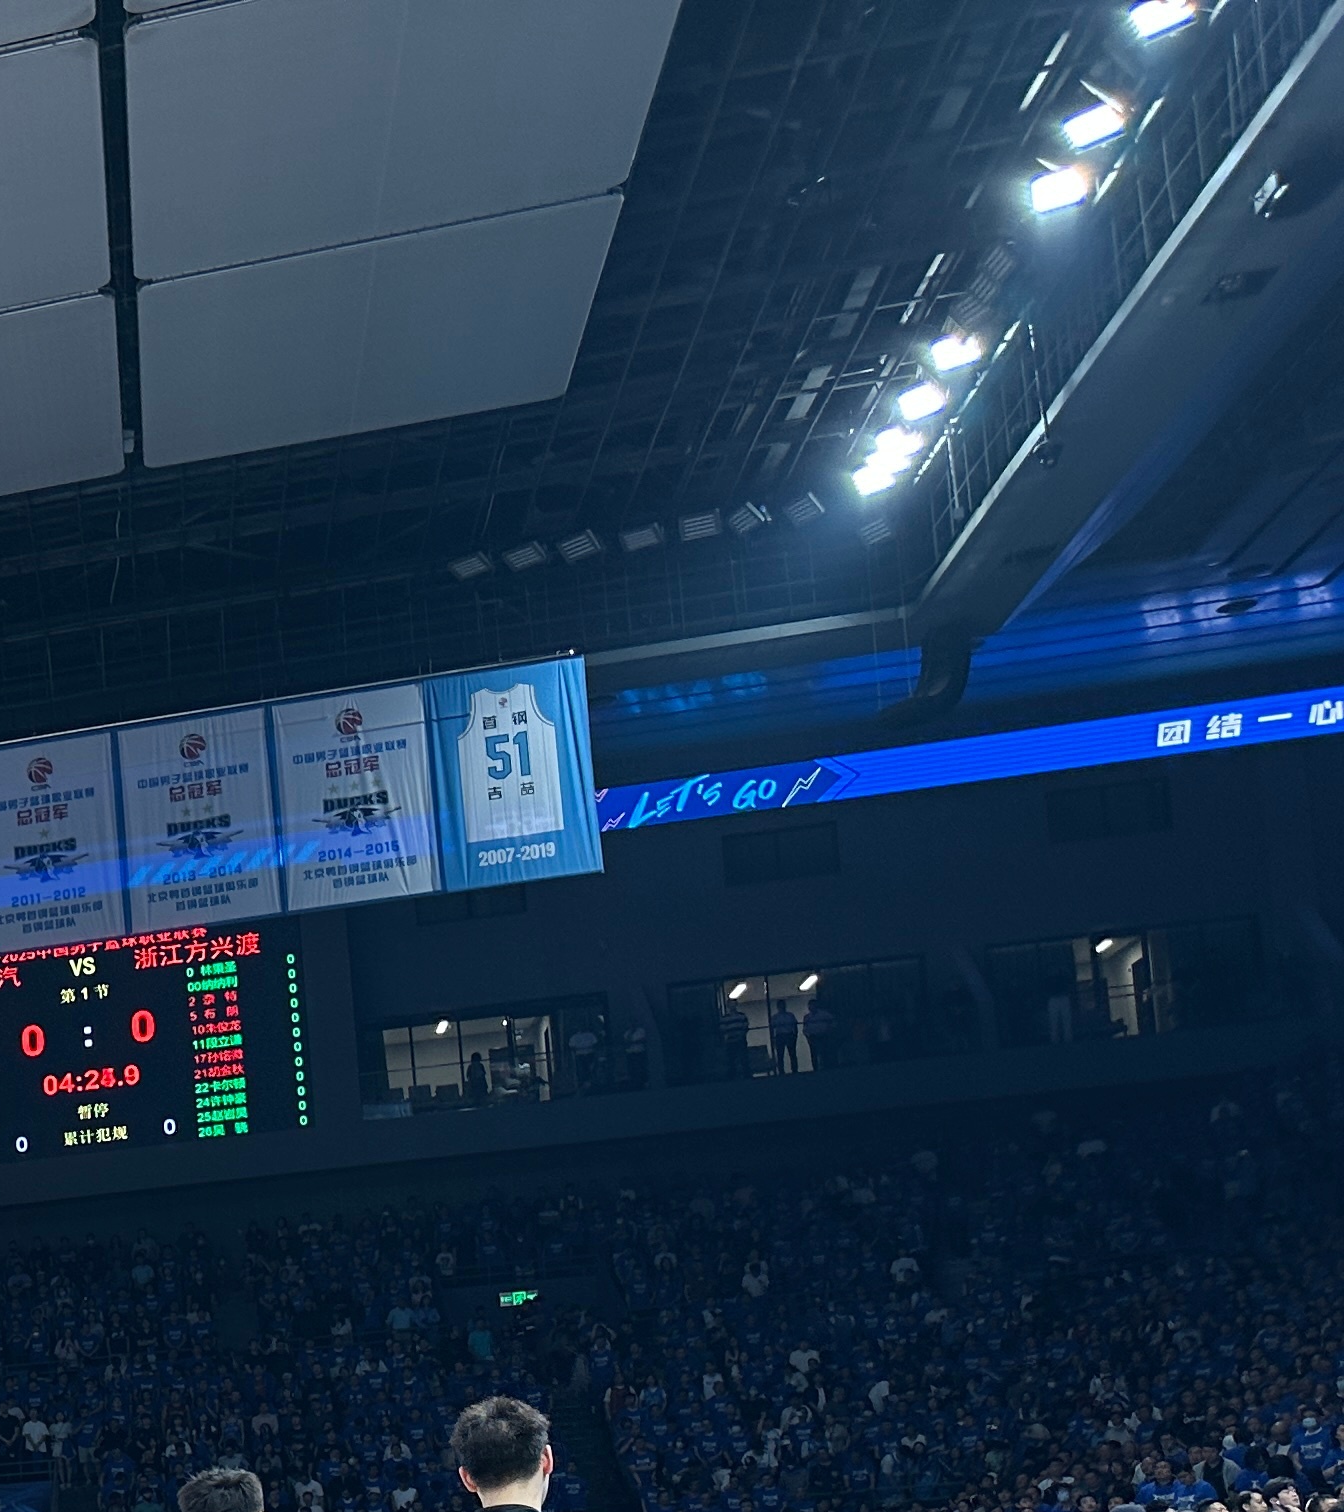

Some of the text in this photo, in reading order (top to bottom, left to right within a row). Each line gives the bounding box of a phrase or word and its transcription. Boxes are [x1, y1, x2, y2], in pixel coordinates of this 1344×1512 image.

[481, 710, 527, 730] 首钢
[1156, 700, 1344, 747] 团结一心
[325, 755, 380, 778] 总冠军
[484, 731, 531, 780] 51
[169, 779, 222, 803] 总冠军
[322, 790, 389, 814] DUCKS
[628, 773, 777, 828] LET'S GO
[16, 804, 68, 827] 总冠军
[166, 814, 231, 837] DUCKS
[13, 838, 77, 861] DUCKS
[478, 841, 556, 867] 2007-2019
[134, 932, 261, 971] 浙江方兴渡
[69, 957, 96, 976] VS
[186, 967, 193, 977] 0
[287, 954, 294, 964] 0
[288, 969, 295, 979] 0
[189, 997, 195, 1007] 2
[289, 983, 297, 993] 0
[190, 1011, 197, 1021] 5
[290, 998, 298, 1008] 0
[292, 1013, 299, 1022] 0
[21, 1024, 45, 1057] 0
[131, 1010, 156, 1042] 0
[293, 1027, 300, 1037] 0
[294, 1042, 301, 1052] 0
[295, 1057, 302, 1066] 0
[296, 1071, 304, 1081] 0
[298, 1086, 305, 1096] 0
[299, 1101, 306, 1110] 0
[300, 1115, 307, 1125] 0
[16, 1118, 177, 1152] 0 累计犯规 0
